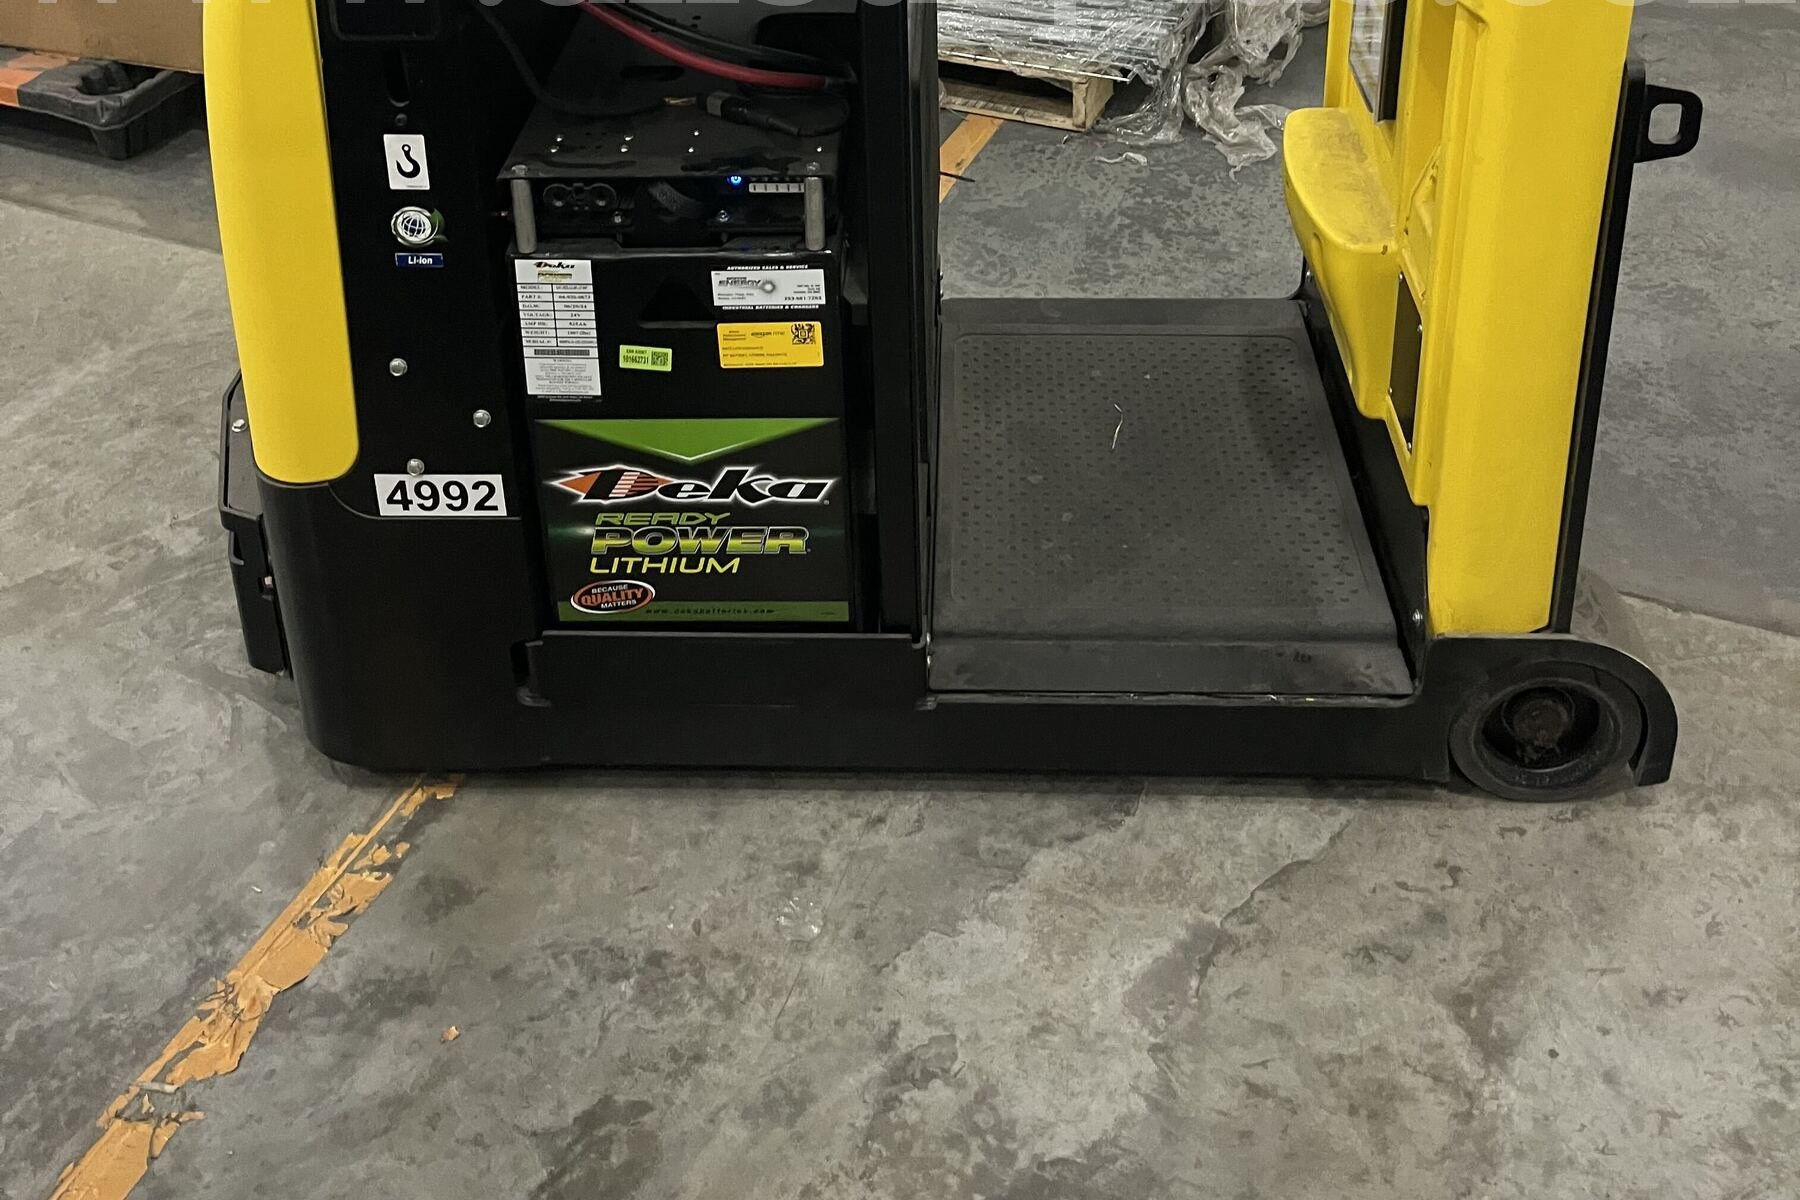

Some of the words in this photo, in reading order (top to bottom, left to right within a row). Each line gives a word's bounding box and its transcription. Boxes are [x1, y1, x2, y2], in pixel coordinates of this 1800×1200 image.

[550, 464, 838, 507] Deka
[386, 480, 499, 511] 4992
[595, 512, 731, 526] READY
[590, 526, 811, 555] POWER
[589, 556, 741, 574] LITHIUM
[581, 587, 644, 607] QUALITY
[591, 583, 629, 594] BECAUSE
[600, 599, 637, 609] MATTERS
